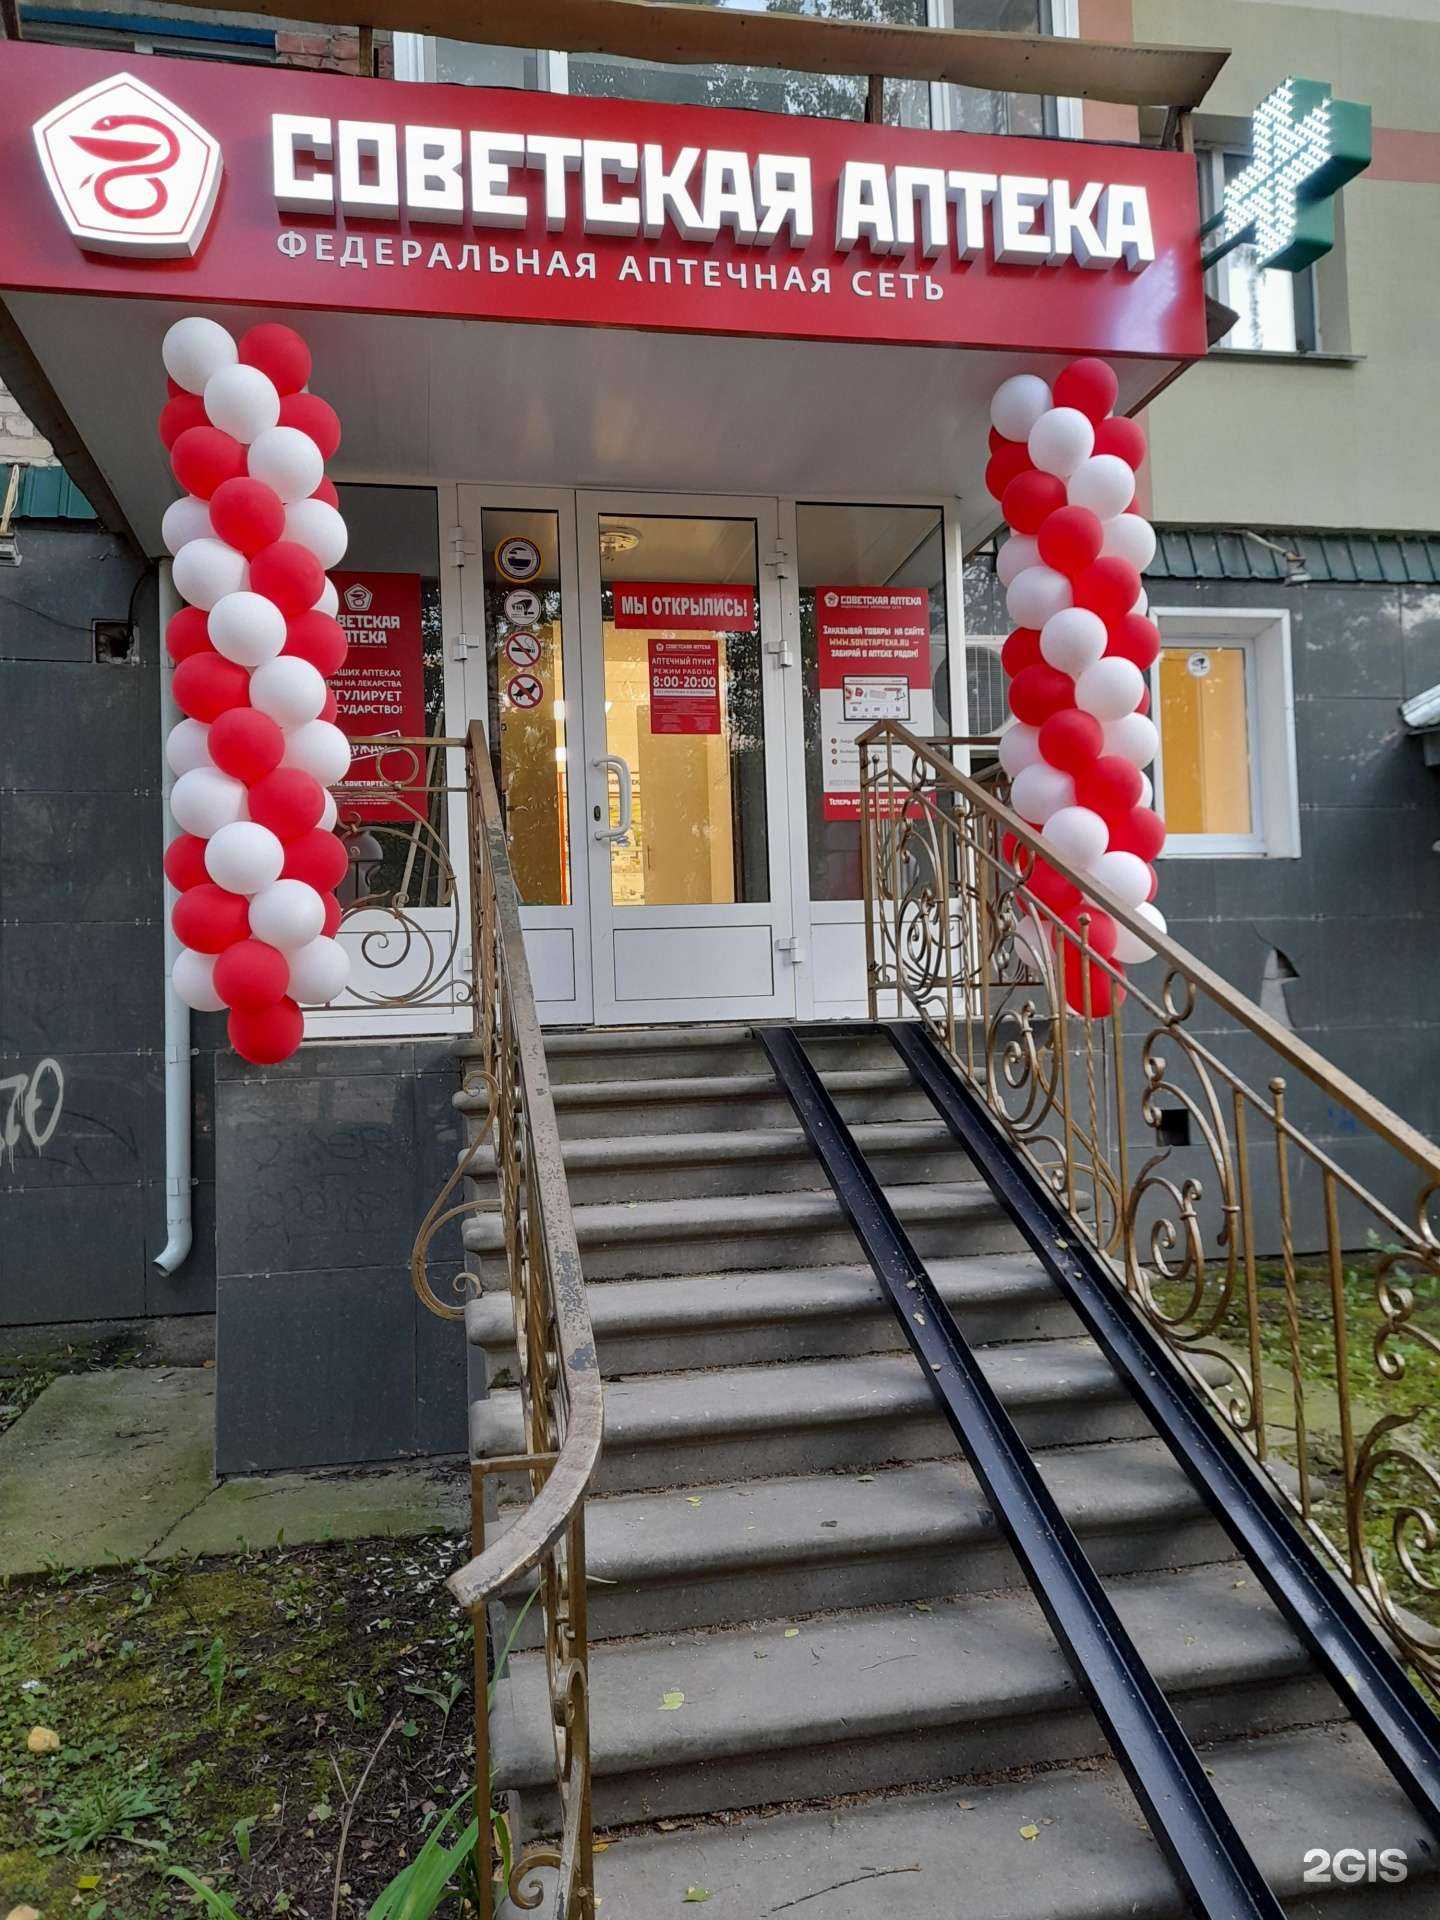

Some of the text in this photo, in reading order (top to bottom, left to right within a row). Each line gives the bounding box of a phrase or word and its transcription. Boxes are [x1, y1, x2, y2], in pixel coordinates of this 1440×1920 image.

[270, 113, 1156, 271] СОВЕТСКАЯ АПТЕКА
[276, 229, 945, 301] ФЕДЕРАЛЬНАЯ АПТЕЧНАЯ СЕТЬ
[621, 595, 748, 617] МЫ ОТКРЫЛИСЬ!
[840, 595, 922, 606] СОВЕТСКАЯ АПТЕКА
[344, 630, 388, 644] ПТЕКА
[651, 655, 716, 666] АПТЕЧНЫЙ ПУНКТ
[334, 668, 402, 678] АШИХ АПТЕКАХ
[653, 667, 681, 675] РЕЖИМ
[344, 679, 357, 687] НА
[357, 680, 402, 688] ЛЕКАРСТВА
[652, 675, 717, 688] 8:00-20:00
